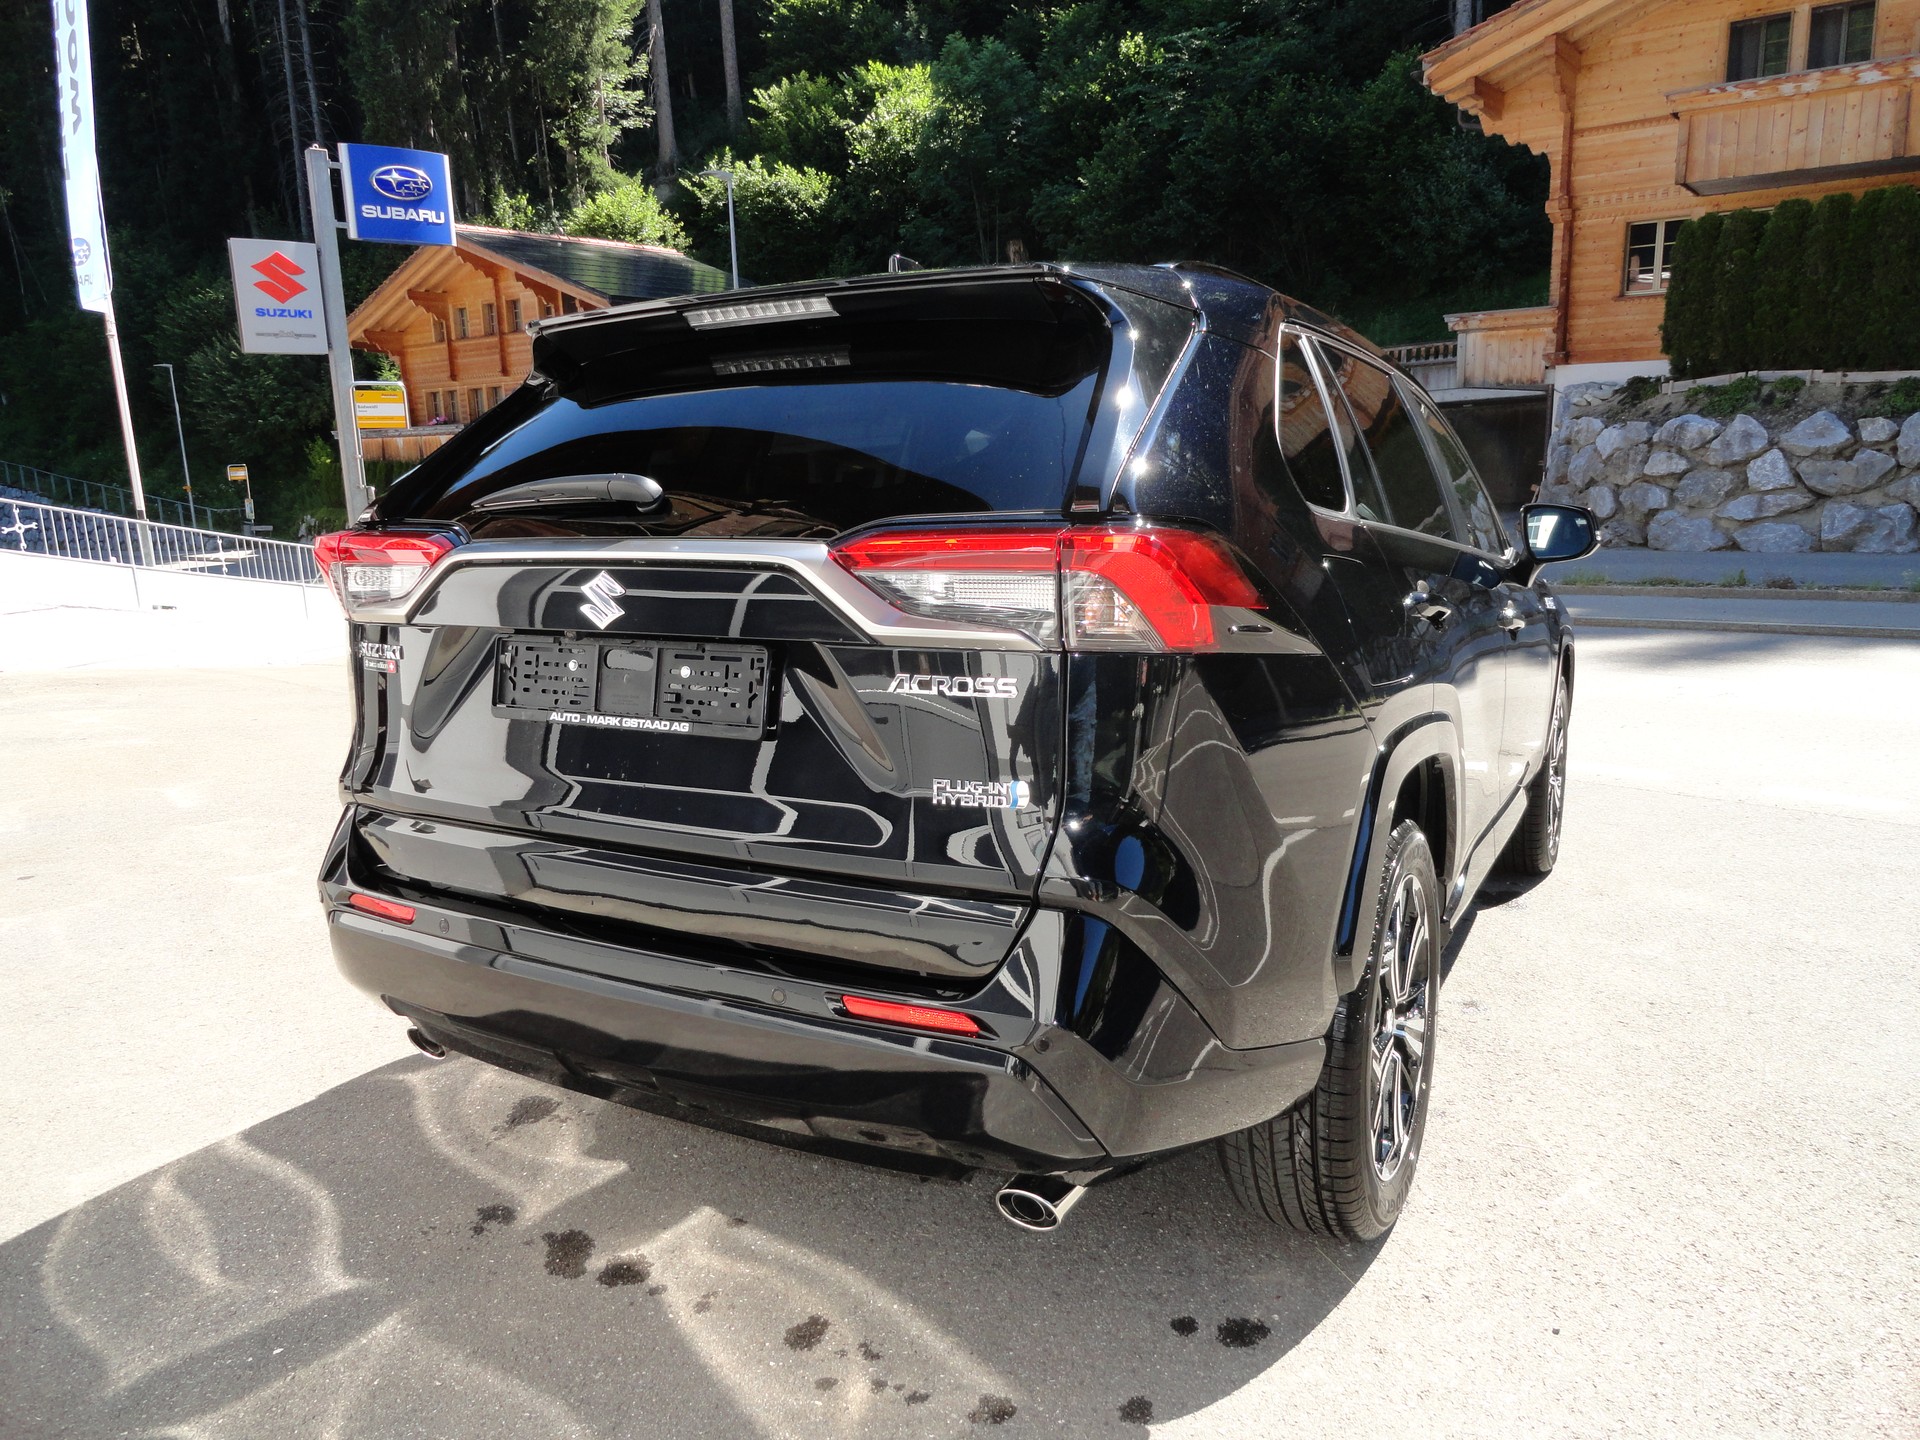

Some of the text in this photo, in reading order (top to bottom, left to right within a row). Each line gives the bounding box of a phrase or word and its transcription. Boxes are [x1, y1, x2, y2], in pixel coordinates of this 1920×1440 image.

[361, 204, 445, 224] SUBARU
[255, 307, 313, 319] SUZUKI
[359, 640, 404, 660] SUZUKI
[887, 673, 1019, 699] ACROSS
[549, 711, 580, 722] AUTO
[586, 714, 621, 727] MARK
[622, 717, 670, 731] GSTAAD
[671, 722, 690, 732] AG
[932, 778, 1009, 795] PLUG-IN
[932, 793, 1011, 808] HYBRID
